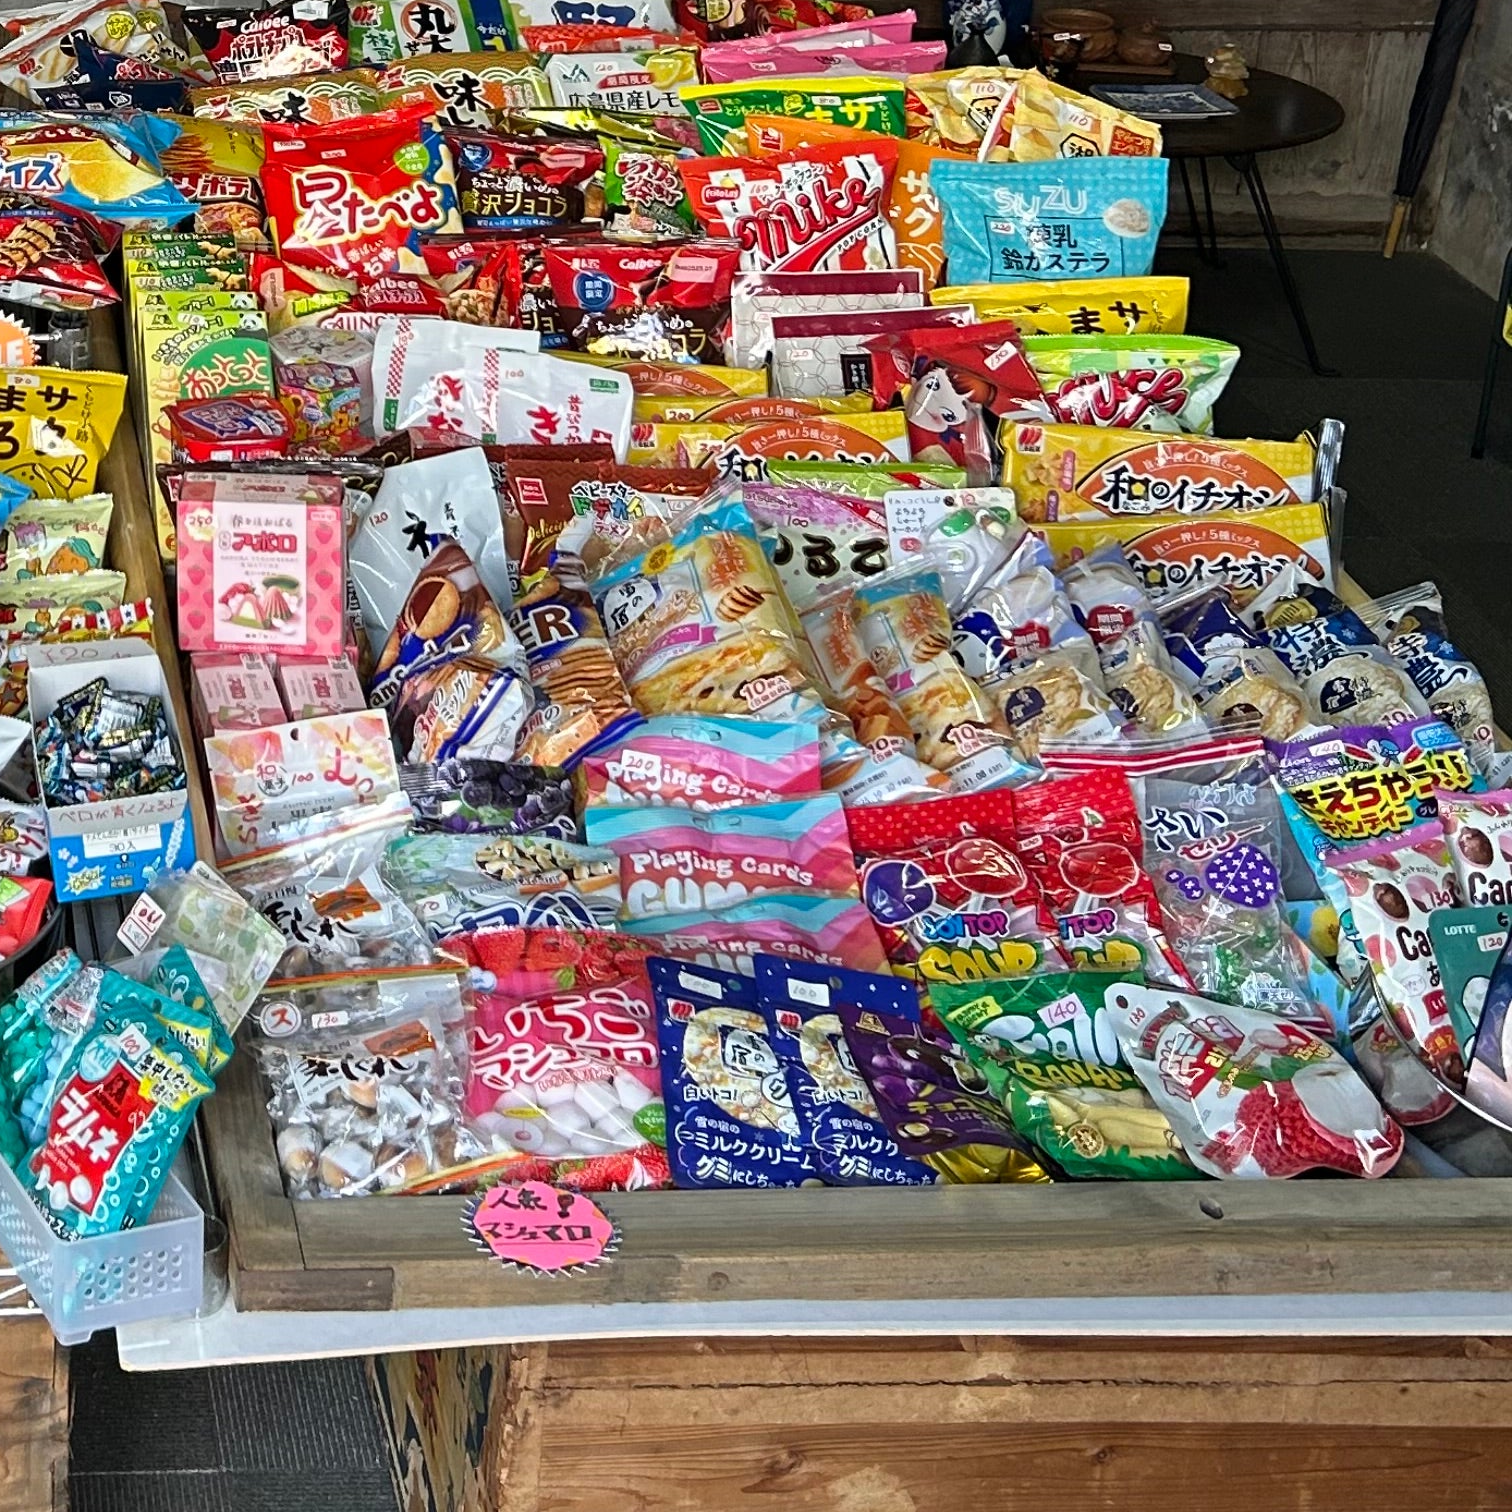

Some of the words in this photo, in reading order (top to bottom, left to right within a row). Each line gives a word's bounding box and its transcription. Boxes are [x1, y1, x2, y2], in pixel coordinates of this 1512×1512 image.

[240, 16, 290, 34] Calbee
[568, 91, 680, 113] 広島県産レモ
[461, 191, 569, 219] 贅沢ショコラ
[738, 176, 882, 263] Mike
[835, 217, 884, 255] POPCORN
[618, 257, 662, 271] Calbee
[1000, 246, 1111, 272] 鈴カステラ
[368, 511, 389, 526] 120
[231, 532, 299, 554] アポロ
[628, 847, 734, 884] Playing
[742, 856, 814, 888] Cards
[1444, 924, 1477, 936] LOTTE
[1046, 999, 1079, 1026] 140
[695, 1132, 817, 1172] ミルククリーム
[481, 1221, 593, 1243] マシュマロ
